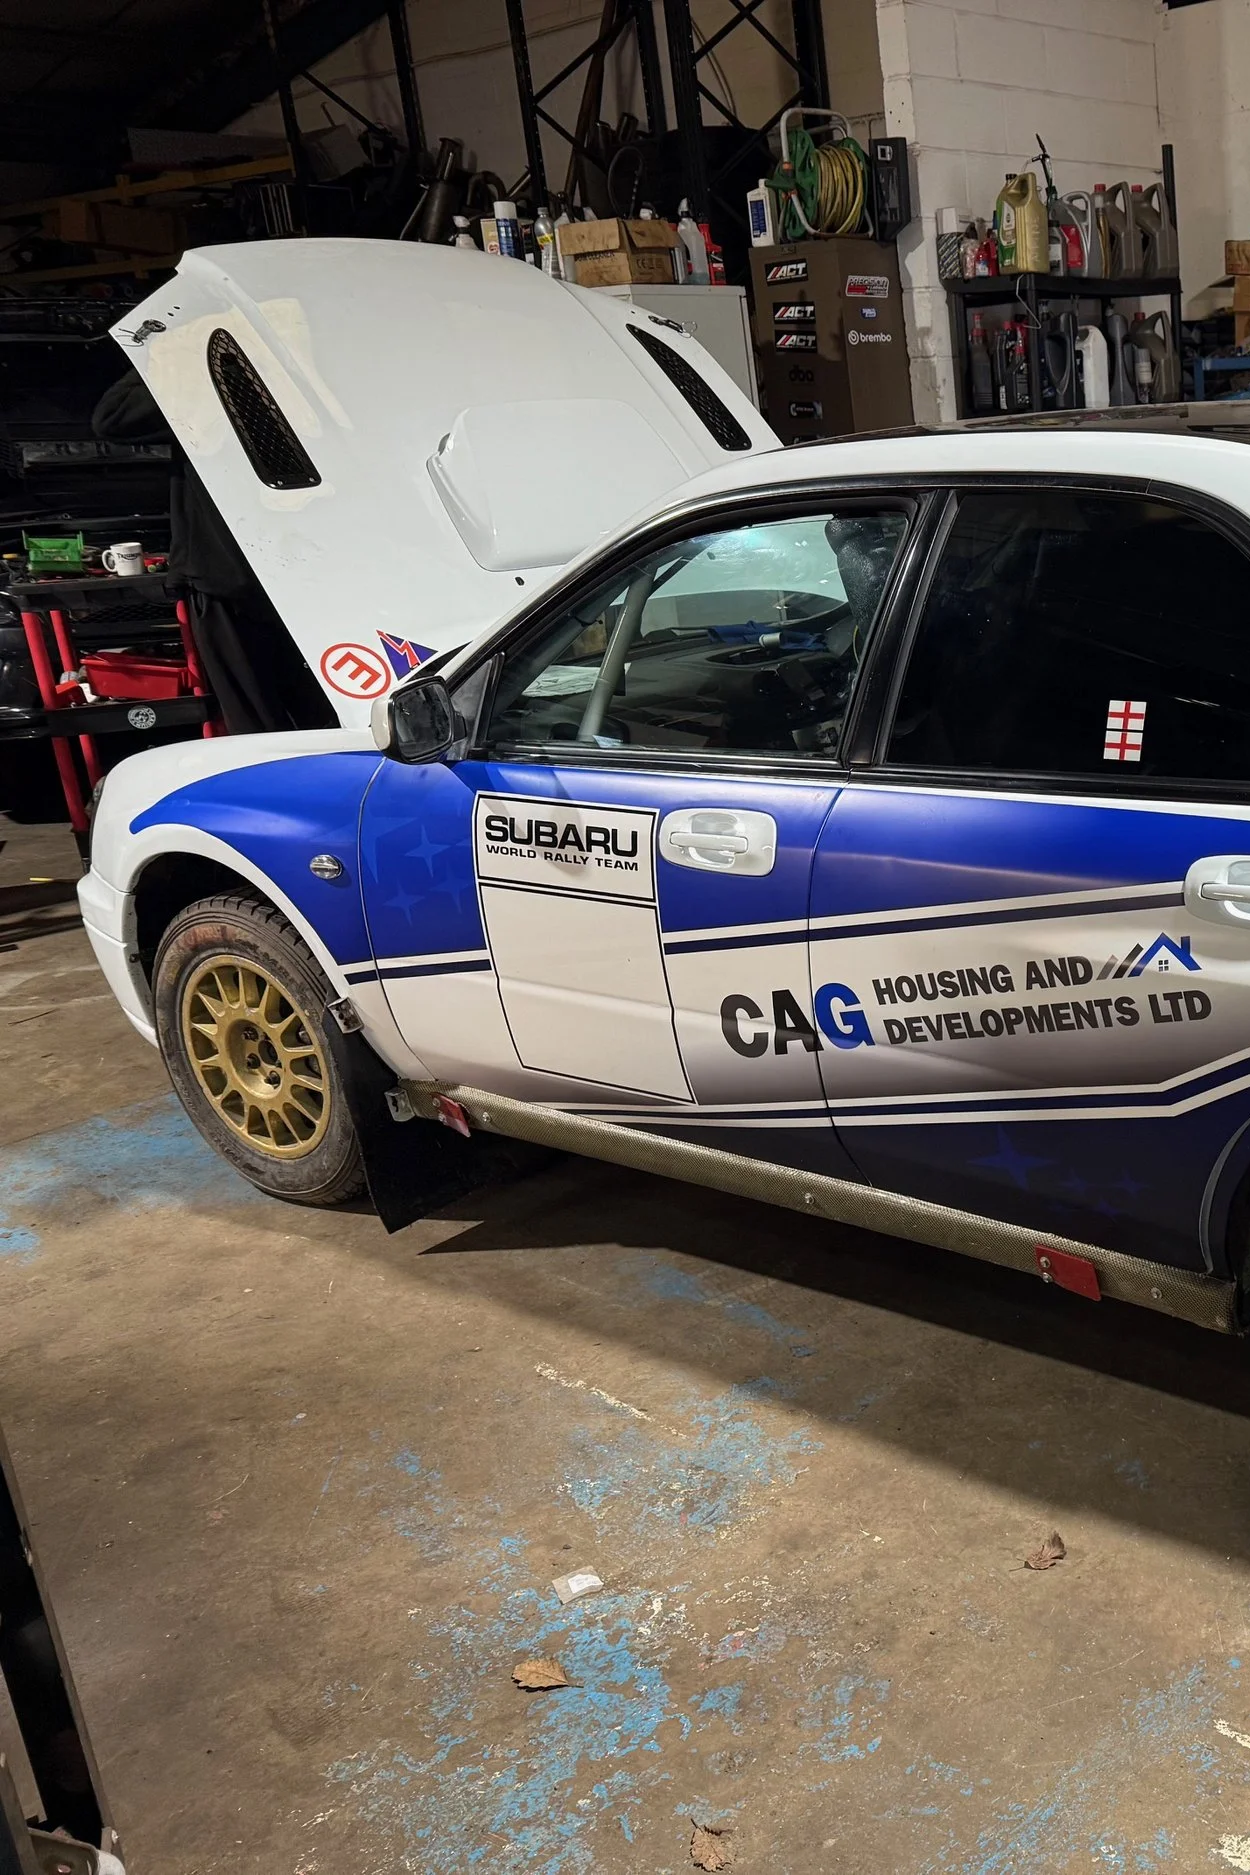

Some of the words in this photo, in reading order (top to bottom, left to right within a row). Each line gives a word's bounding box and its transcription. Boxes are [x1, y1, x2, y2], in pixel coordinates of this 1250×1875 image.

[777, 262, 807, 278] ACT
[784, 305, 815, 318] ACT
[785, 334, 816, 348] ACT
[859, 332, 892, 343] brembo
[485, 814, 638, 858] SUBARU
[486, 844, 537, 859] WORLD
[544, 851, 589, 865] RALLY
[595, 857, 638, 871] TEAM
[872, 965, 1014, 1006] HOUSING
[1025, 956, 1093, 991] AND
[720, 983, 875, 1058] CAG
[883, 999, 1140, 1045] DEVELOPMENTS
[1147, 989, 1212, 1024] LTD
